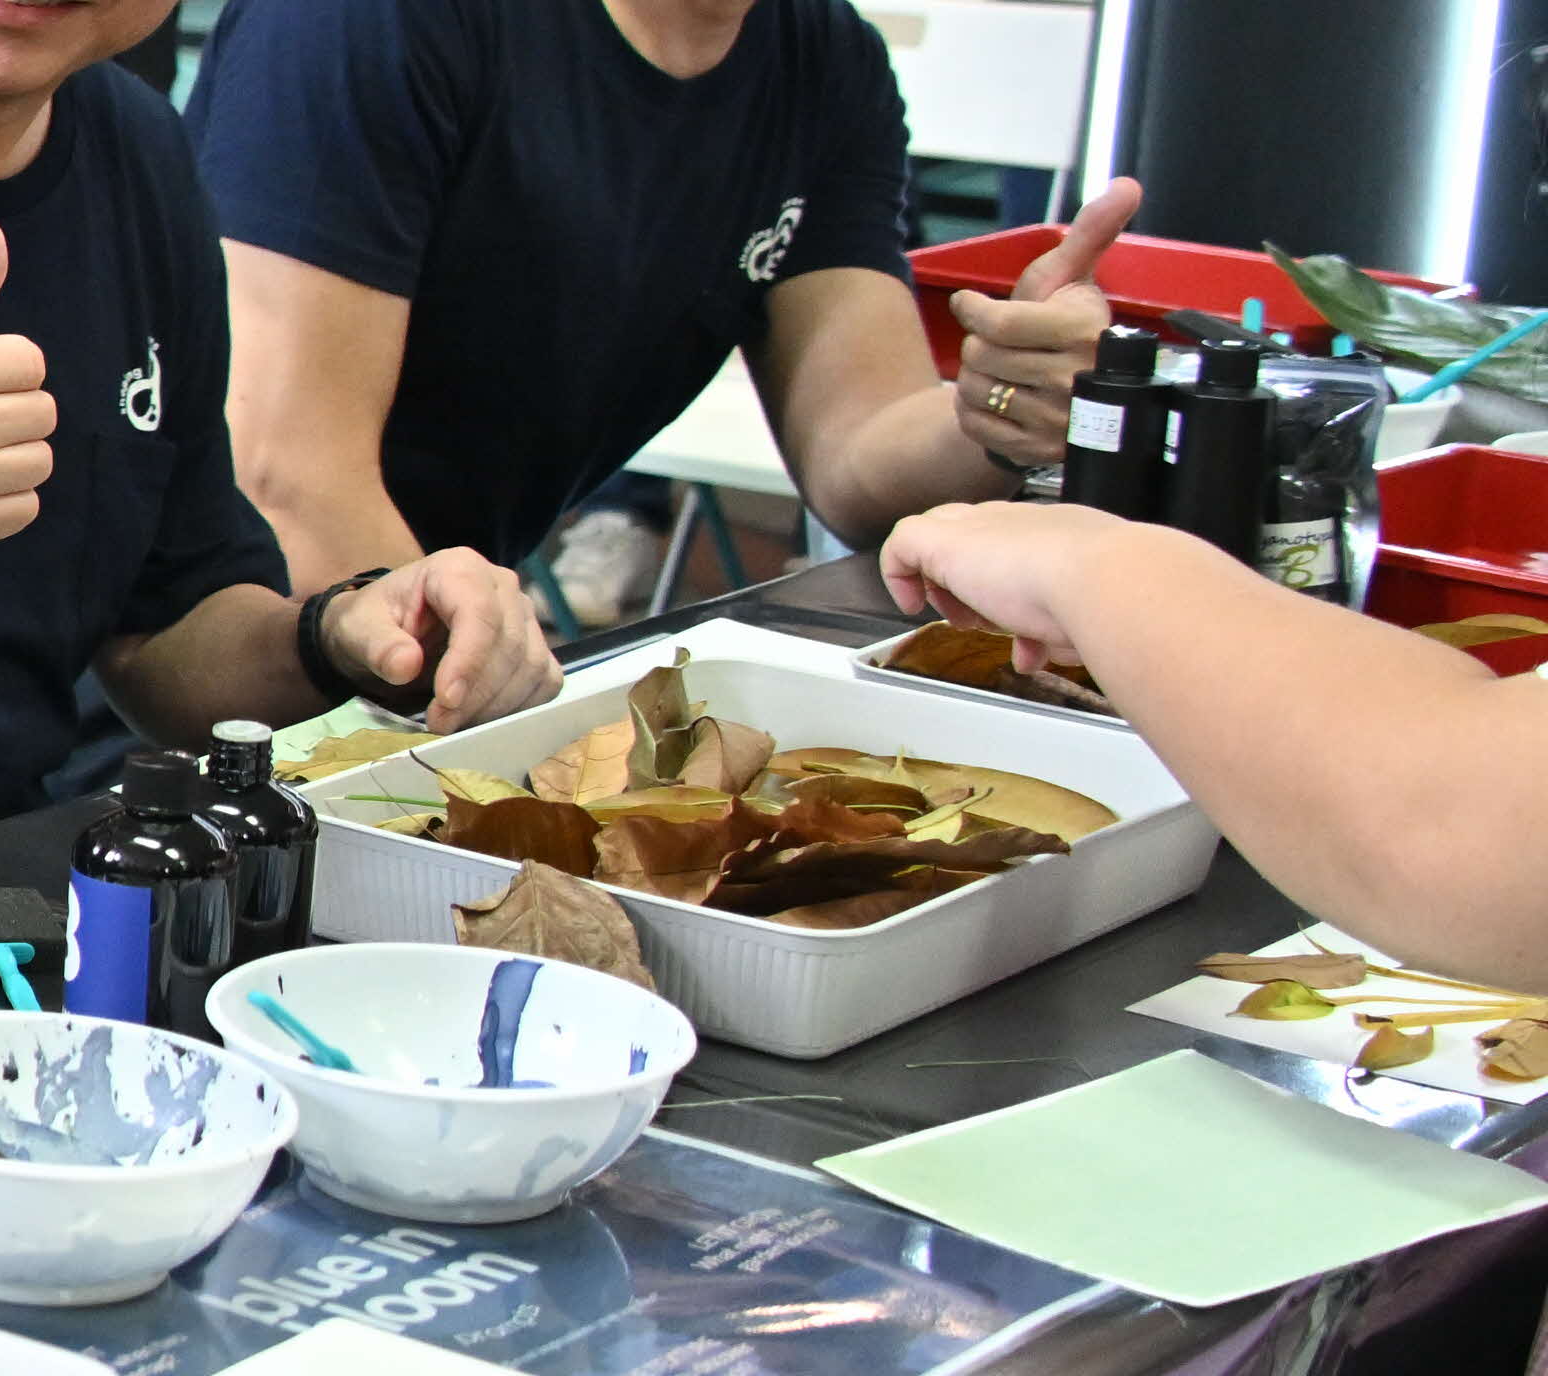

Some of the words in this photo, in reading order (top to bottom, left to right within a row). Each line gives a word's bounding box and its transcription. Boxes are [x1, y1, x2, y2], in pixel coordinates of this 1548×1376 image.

[199, 1253, 388, 1325] blue
[339, 1227, 458, 1264] in
[280, 1251, 540, 1333] loom
